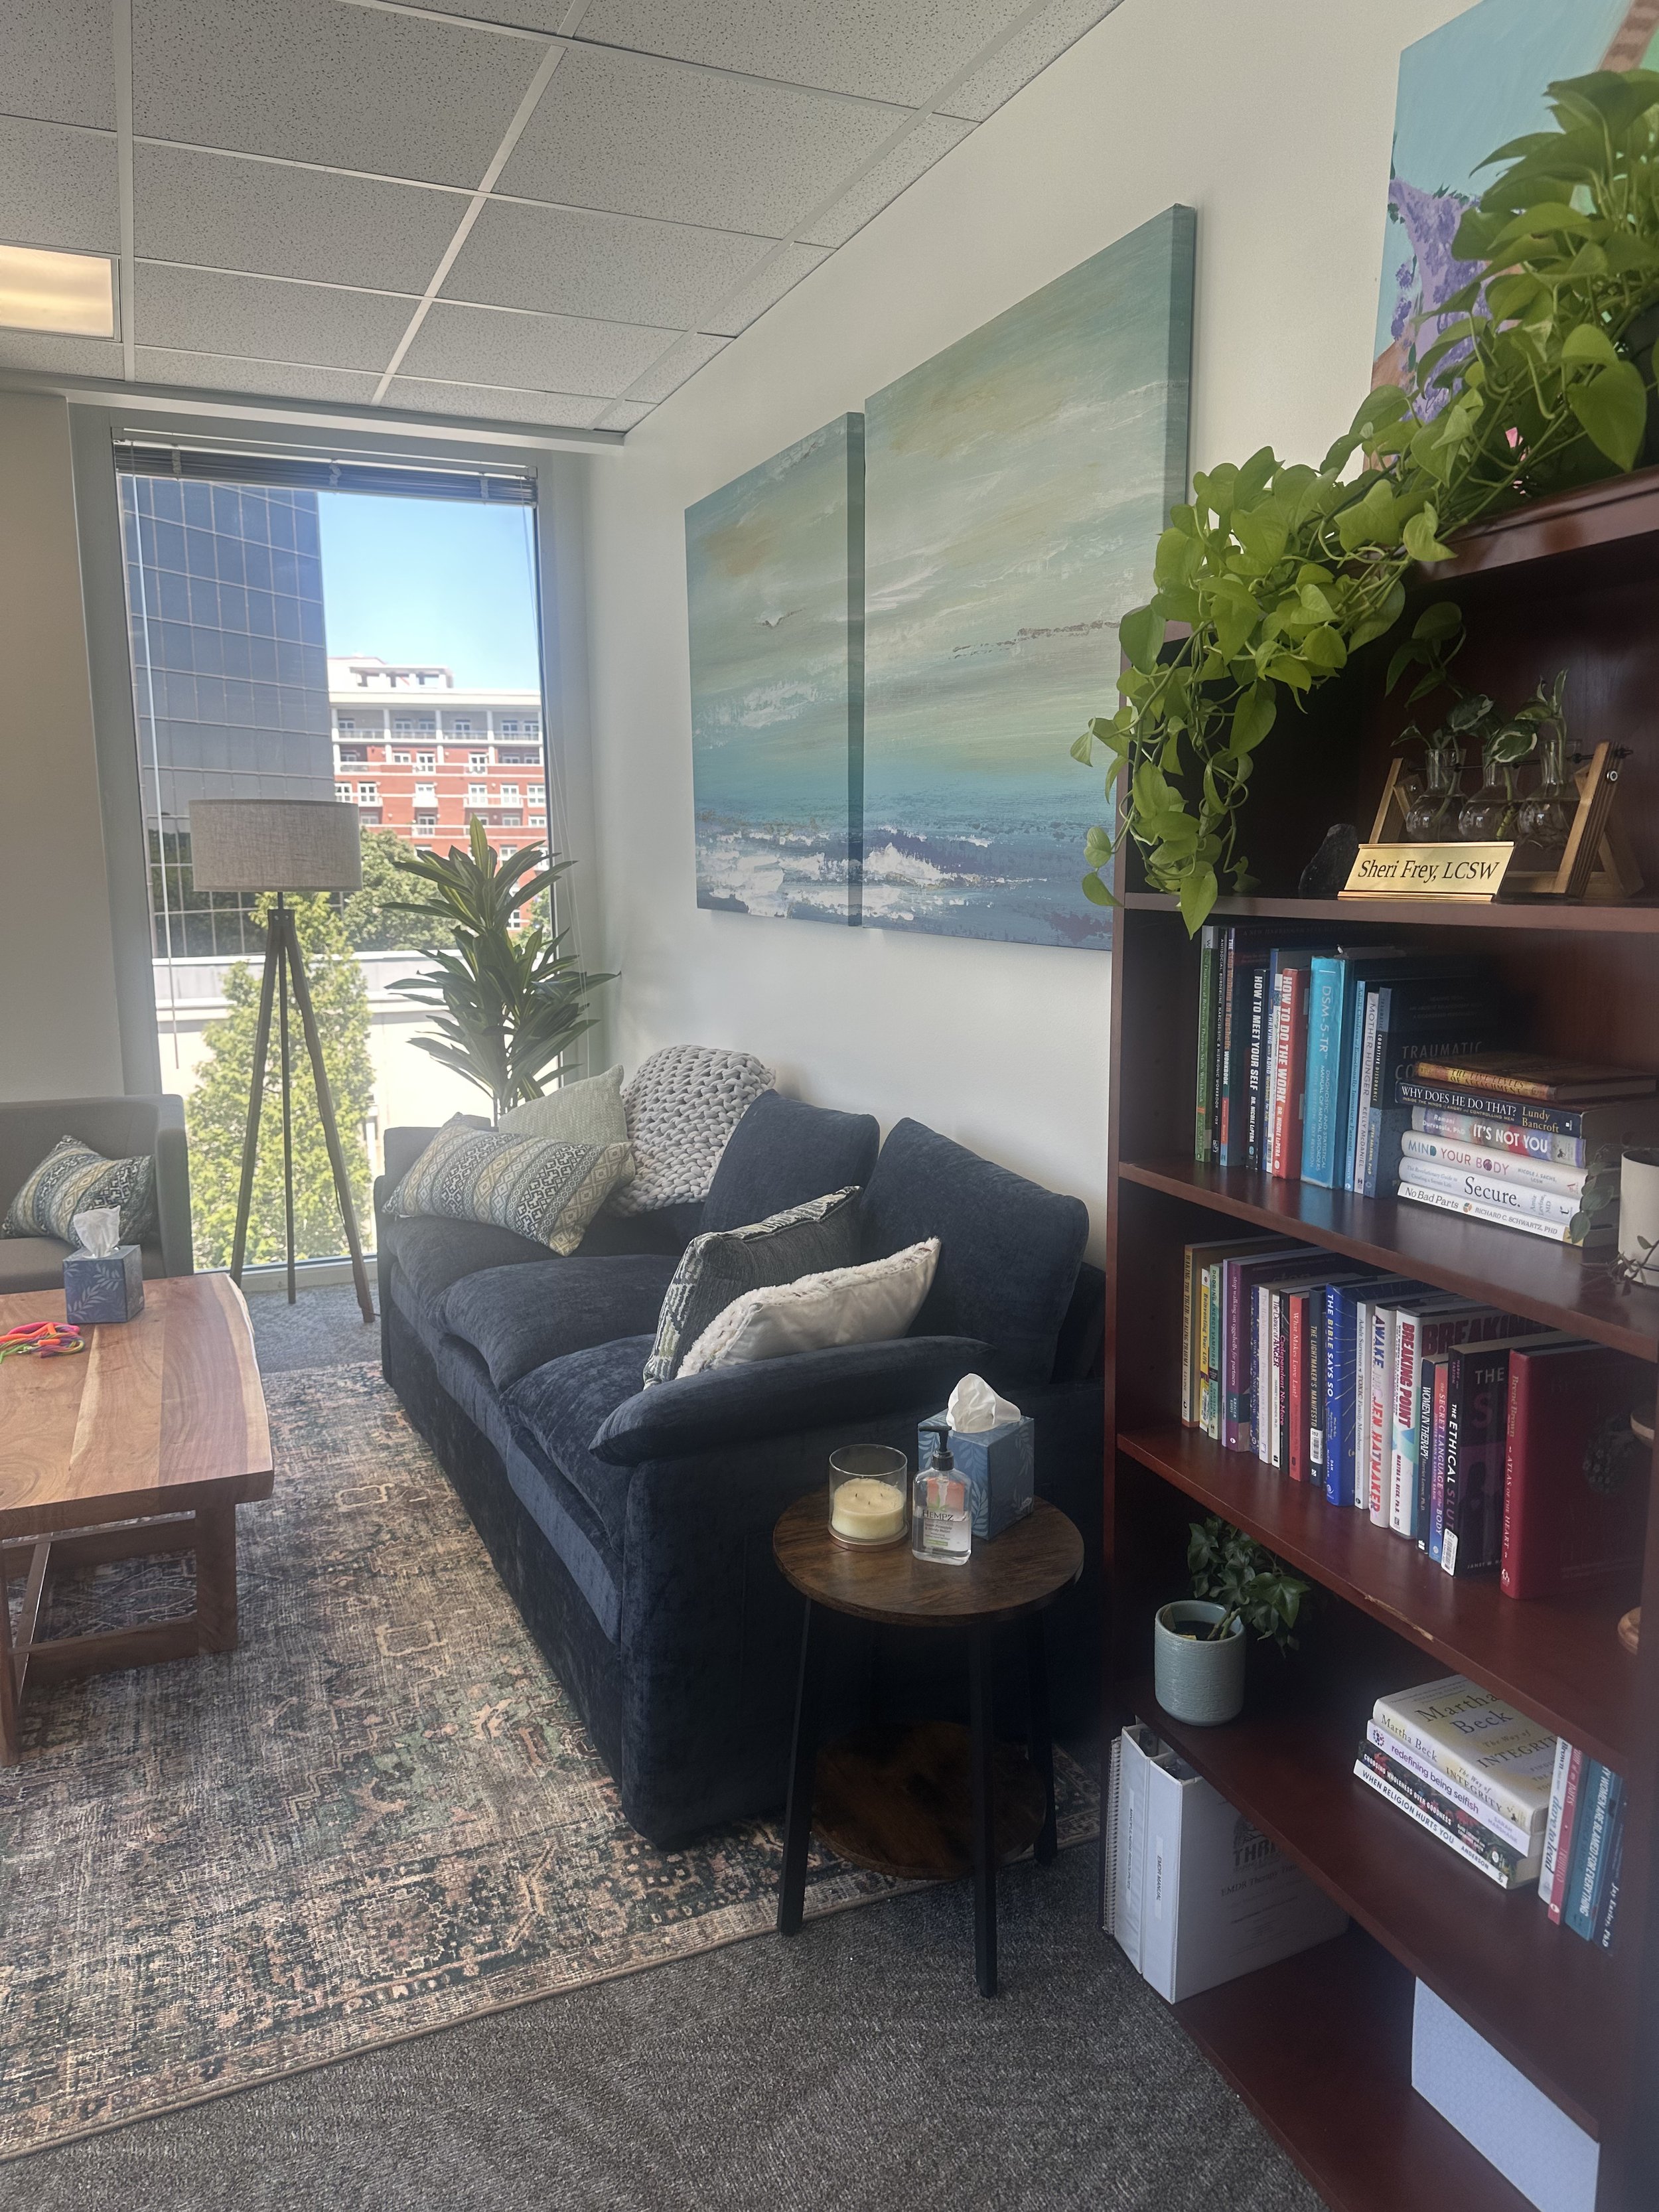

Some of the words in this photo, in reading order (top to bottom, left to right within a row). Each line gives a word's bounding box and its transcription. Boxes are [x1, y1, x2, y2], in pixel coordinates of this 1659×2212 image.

[1358, 860, 1398, 878] Sheri
[1400, 860, 1437, 883] Frey,
[1442, 861, 1500, 880] LCSW
[1254, 976, 1263, 999] HOW
[1281, 976, 1293, 1005] HOW
[1253, 1001, 1262, 1013] TO
[1281, 1007, 1291, 1022] TO
[1252, 1015, 1261, 1040] MEET
[1279, 1025, 1290, 1041] DO
[1366, 1003, 1376, 1047] MOTHER
[1250, 1041, 1260, 1068] YOUR
[1278, 1045, 1289, 1066] THE
[1402, 1041, 1482, 1059] TRAUMATIC
[1250, 1069, 1259, 1090] SELF
[1276, 1069, 1287, 1104] WORK
[1363, 1052, 1374, 1096] HUNGER
[1451, 1069, 1466, 1078] THE
[1469, 1071, 1490, 1082] FIVE
[1492, 1076, 1524, 1089] LEVELS
[1402, 1086, 1423, 1099] WHY
[1425, 1090, 1449, 1104] DOES
[1452, 1094, 1465, 1107] HE
[1467, 1098, 1483, 1110] DO
[1485, 1101, 1517, 1117] THAT?
[1469, 1109, 1502, 1120] CONTROLLING
[1522, 1106, 1550, 1123] Lundy
[1433, 1114, 1455, 1124] Ramani
[1522, 1117, 1559, 1134] Bancroft
[1358, 1130, 1367, 1167] McDANIEL
[1473, 1124, 1492, 1140] IT'S
[1495, 1129, 1520, 1147] NOT
[1523, 1136, 1548, 1153] YOU
[1408, 1140, 1437, 1157] MIND
[1441, 1147, 1471, 1165] YOUR
[1475, 1157, 1510, 1175] BODY
[1517, 1168, 1535, 1177] NICOLE
[1406, 1187, 1417, 1198] No
[1417, 1191, 1435, 1202] Bad
[1435, 1195, 1459, 1209] Parts
[1464, 1176, 1520, 1207] Secure.
[1475, 1207, 1502, 1219] RICHARD
[1508, 1216, 1544, 1232] SCHWARTZ,
[1544, 1226, 1558, 1234] PHD
[1546, 1201, 1551, 1214] MD
[1374, 1315, 1386, 1369] AWAKE
[1400, 1321, 1415, 1387] BREAKING
[1475, 1366, 1505, 1385] THE
[1280, 1391, 1285, 1402] No
[1327, 1382, 1334, 1397] SO
[1421, 1386, 1431, 1414] WOMEN
[1372, 1396, 1384, 1428] JEN
[1398, 1387, 1412, 1428] POINT
[1421, 1415, 1430, 1424] IN
[1420, 1425, 1430, 1459] THERAPY
[1447, 1421, 1458, 1483] ETHICAL
[1370, 1431, 1383, 1512] HATMAKER
[1437, 1434, 1445, 1489] LANGUAGE
[1505, 1489, 1510, 1499] OF
[922, 1509, 954, 1521] HEMPZ
[1445, 1488, 1455, 1530] SLUT
[1415, 1693, 1500, 1722] Martha
[1449, 1710, 1514, 1734] Beck
[1380, 1714, 1412, 1744] Martha
[1415, 1737, 1438, 1762] Beck
[1559, 1741, 1569, 1769] Brown
[1364, 1753, 1386, 1775] CHOOSING
[1387, 1770, 1413, 1795] WHOLENESS
[1413, 1792, 1426, 1806] OVER
[1426, 1802, 1452, 1826] GOODNESS
[1391, 1745, 1429, 1779] redefining
[1430, 1771, 1453, 1795] being
[1454, 1790, 1479, 1814] selfish
[1445, 1767, 1502, 1812] INTEGRITY
[1459, 1767, 1469, 1778] The
[1471, 1775, 1482, 1789] Way
[1597, 1776, 1610, 1808] WOMEN
[1362, 1770, 1382, 1789] WHEN
[1383, 1786, 1415, 1814] RELIGION
[1415, 1809, 1437, 1832] HURTS
[1439, 1828, 1455, 1844] YOU
[1461, 1846, 1490, 1870] ANDERSON
[1493, 1816, 1514, 1832] SARAH
[1551, 1795, 1562, 1826] dare
[1593, 1805, 1605, 1824] ARE
[1548, 1828, 1557, 1842] to
[1589, 1822, 1603, 1857] BLAMED
[1545, 1843, 1557, 1874] lead
[1586, 1854, 1597, 1870] FOR
[1579, 1868, 1595, 1917] EVERYTHING
[1611, 1882, 1619, 1897] Jay
